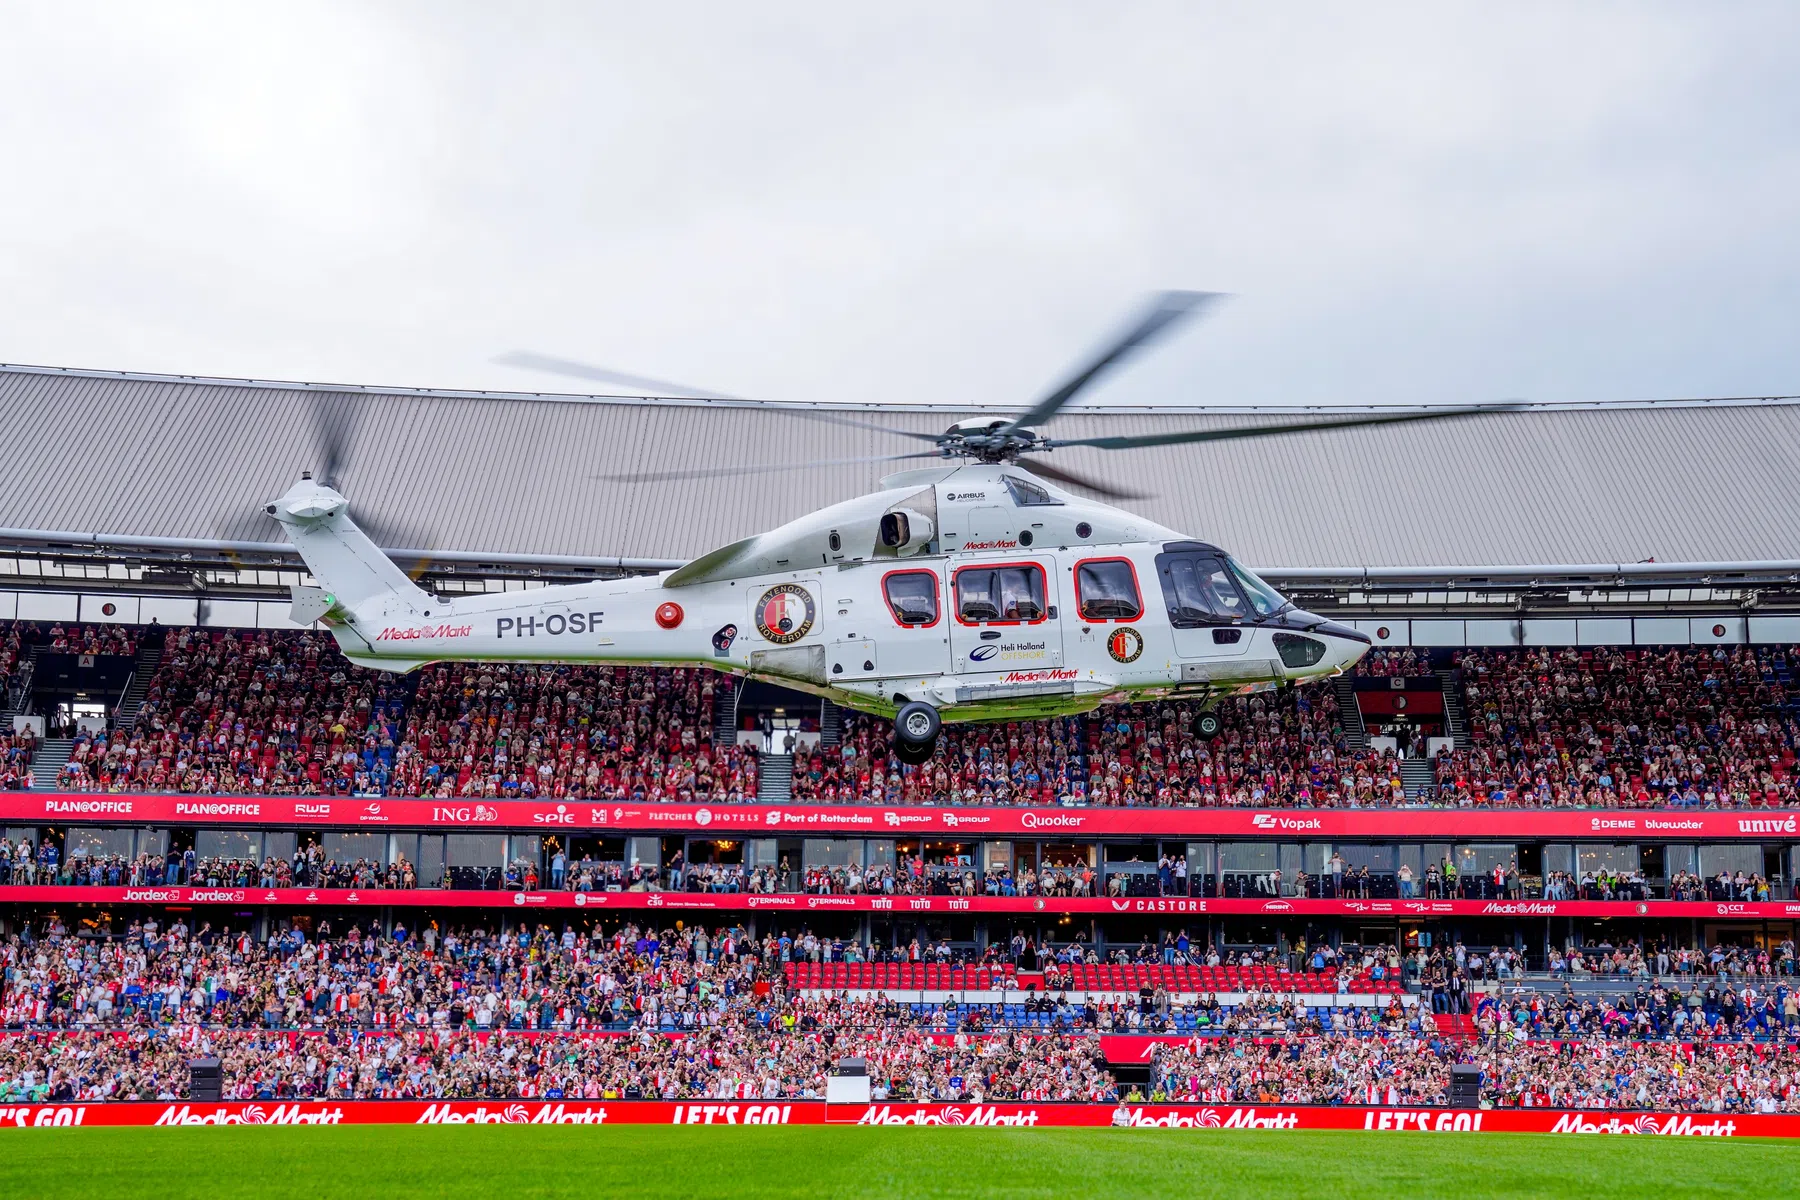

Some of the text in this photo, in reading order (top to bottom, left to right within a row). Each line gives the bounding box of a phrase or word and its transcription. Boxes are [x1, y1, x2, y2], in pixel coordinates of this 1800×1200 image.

[957, 491, 986, 499] AIRBUS
[963, 540, 1017, 550] Media Markt
[758, 585, 811, 608] FEYENOORD
[496, 611, 604, 639] PH-OSF
[758, 618, 812, 644] ROTTERDAM
[376, 624, 472, 641] Media Markt
[1109, 627, 1141, 641] FEYENOORD
[1000, 642, 1045, 652] Heli Holland
[82, 656, 90, 665] A
[1001, 650, 1045, 661] OFFSHORE
[1109, 649, 1142, 663] ROTTERDAM
[1005, 669, 1079, 683] Media Markt
[45, 801, 133, 813] PLAN@OFFICE
[176, 803, 260, 816] PLAN@OFFICE
[295, 804, 330, 813] RWG
[433, 807, 471, 821] ING
[649, 812, 693, 821] FLETCHER
[714, 813, 759, 822] HOTELS
[784, 814, 873, 824] Port of Rotterdam
[1021, 812, 1083, 829] Quooker
[1279, 818, 1322, 831] Vopak
[1601, 820, 1636, 829] DEME
[1645, 820, 1703, 830] bluewater
[1738, 815, 1796, 833] univé
[122, 890, 169, 901] Jordex
[188, 890, 233, 901] Jordex
[871, 898, 893, 909] TOTO
[910, 898, 931, 909] TOTO
[948, 898, 969, 909] TOTO
[1136, 900, 1207, 911] CASTORE
[1482, 903, 1556, 914] Media Markt
[34, 1107, 86, 1127] GO!
[154, 1104, 344, 1126] Media Markt
[416, 1103, 607, 1124] Media Markt
[673, 1105, 792, 1125] LET'S GO!
[857, 1105, 1039, 1127] Media Markt
[1219, 1108, 1298, 1129] Markt
[1364, 1111, 1483, 1132] LET'S GO!
[1659, 1114, 1736, 1137] Markt
